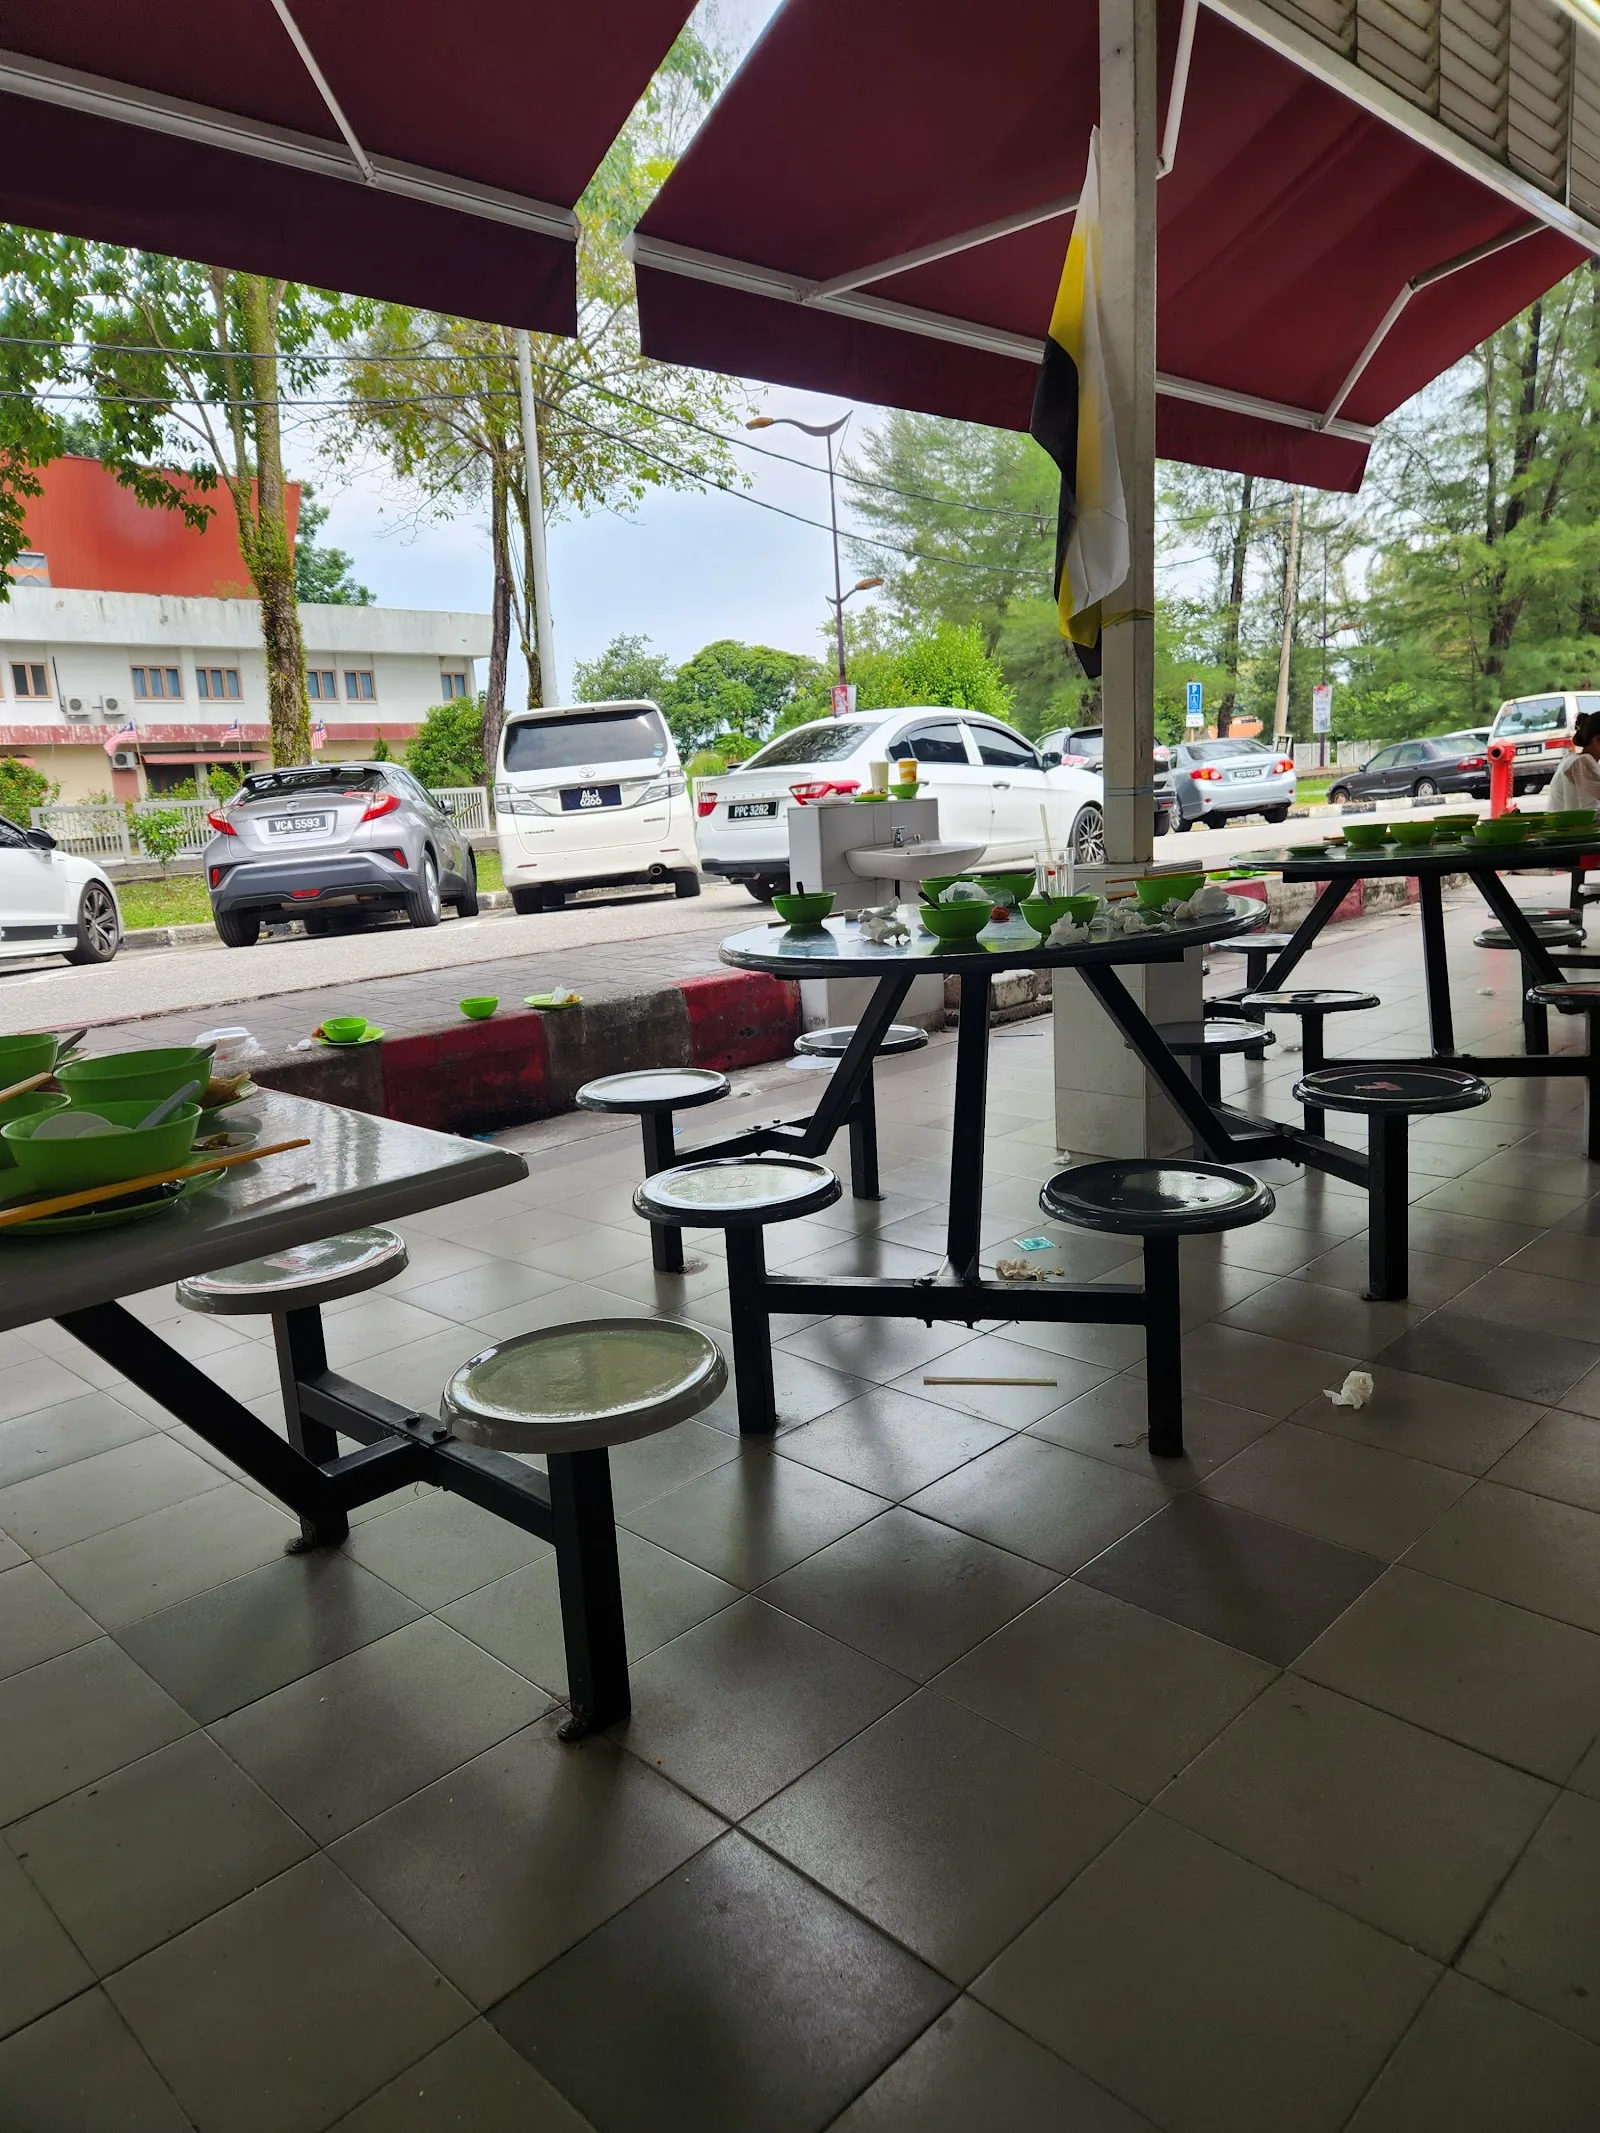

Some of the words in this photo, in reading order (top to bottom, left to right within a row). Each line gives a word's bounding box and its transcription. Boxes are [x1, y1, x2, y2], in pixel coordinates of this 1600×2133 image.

[581, 789, 599, 798] ALJ
[580, 797, 602, 807] 6266
[734, 806, 749, 817] PPC
[749, 804, 769, 816] 3282
[274, 820, 293, 831] VCA
[294, 818, 320, 829] 5593
